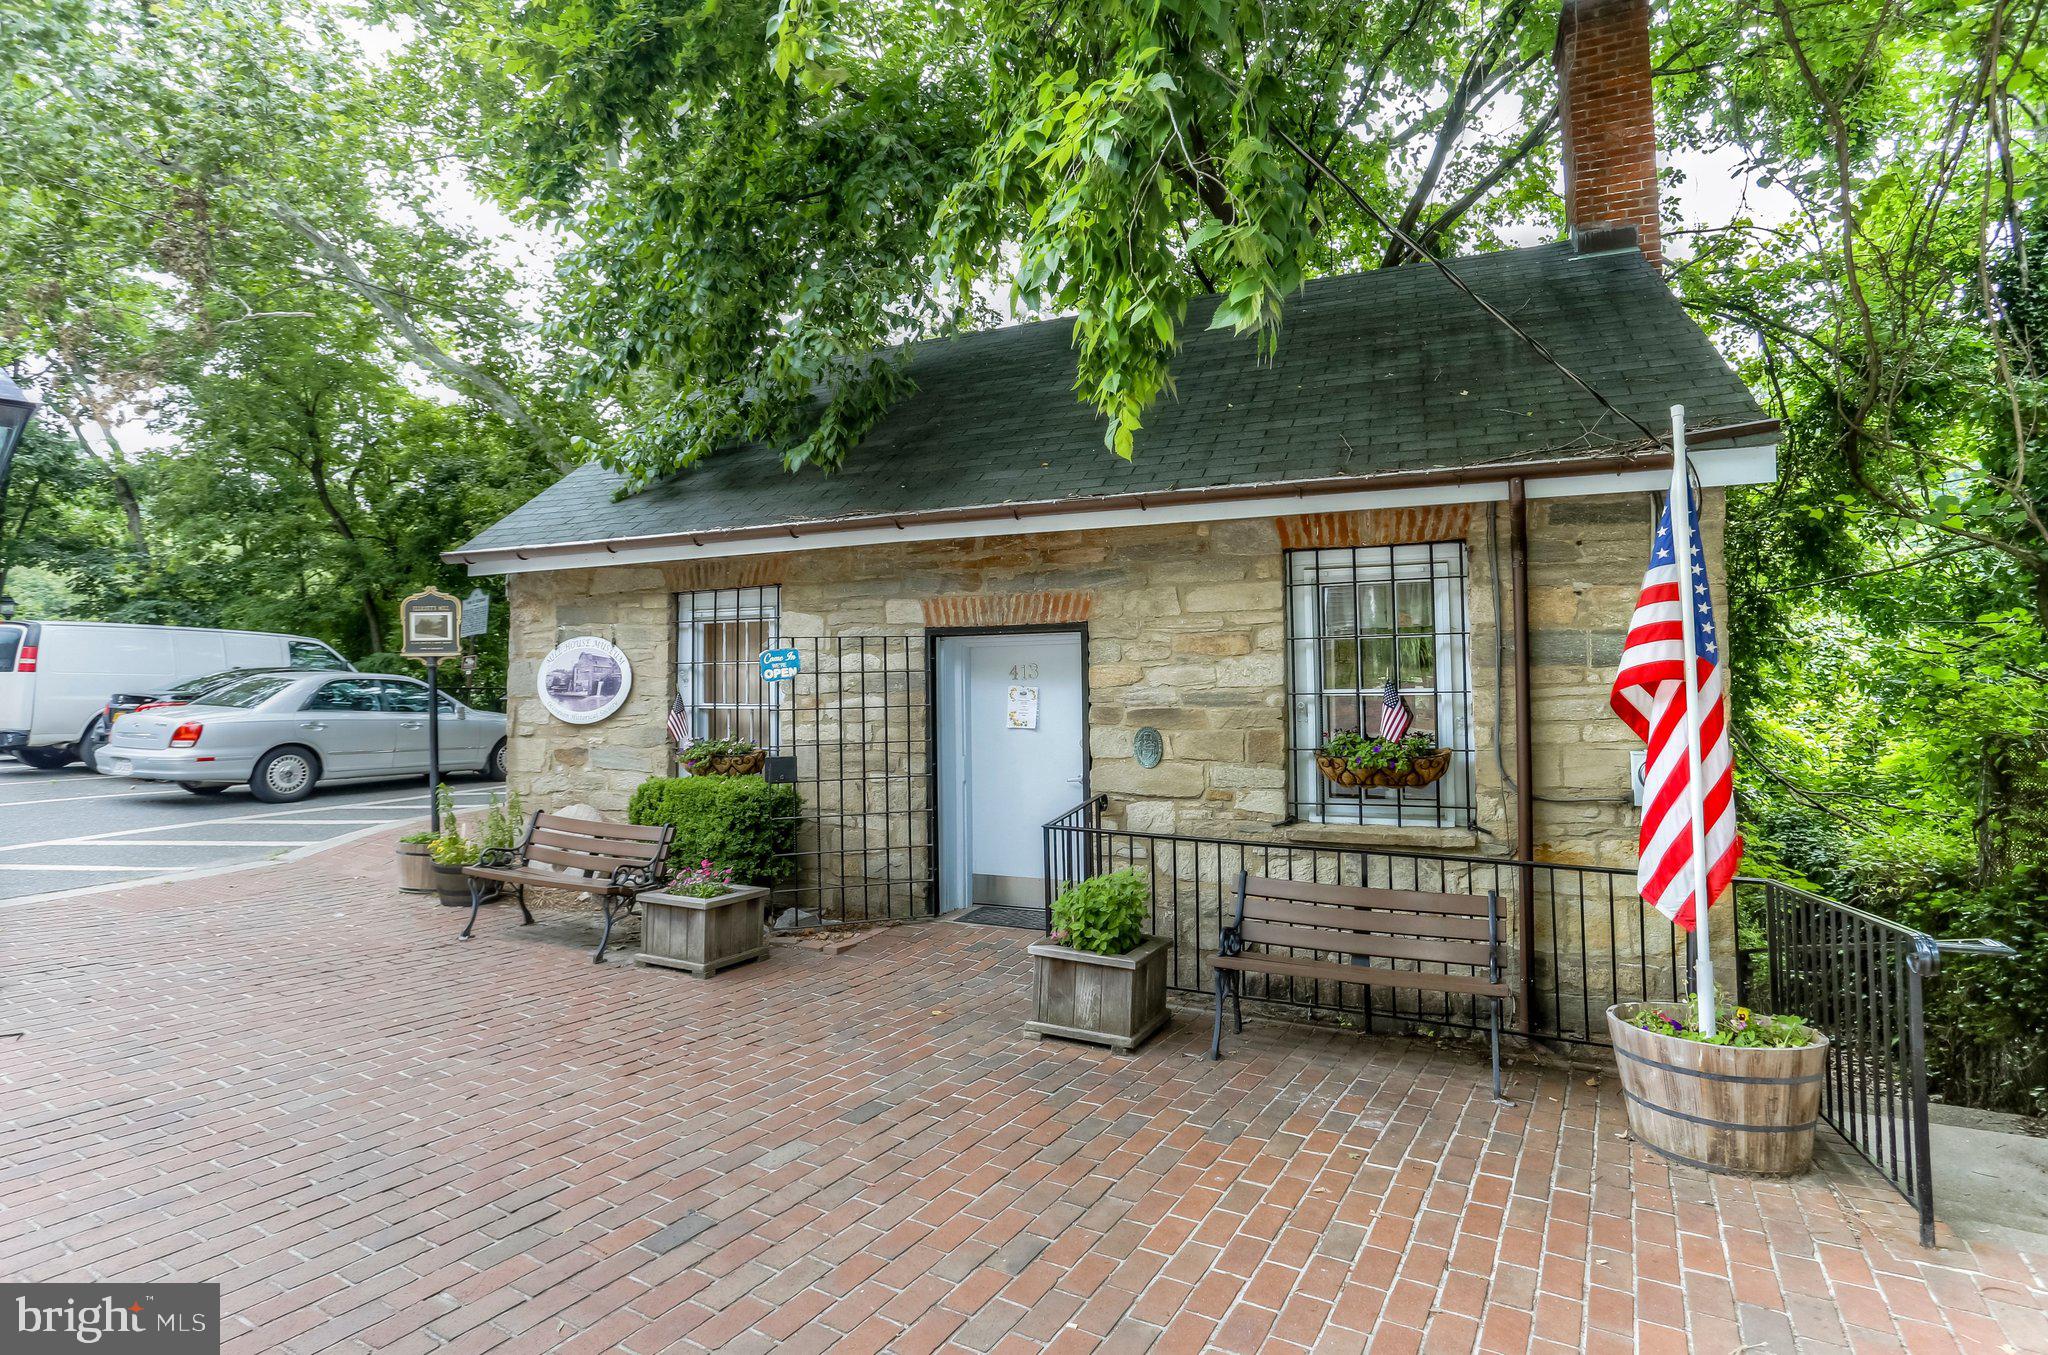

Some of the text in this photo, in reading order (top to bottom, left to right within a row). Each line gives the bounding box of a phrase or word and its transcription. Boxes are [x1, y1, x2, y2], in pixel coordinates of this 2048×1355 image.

[565, 639, 590, 651] HOUSE
[593, 640, 626, 664] MUSEUM
[763, 651, 797, 664] Come In
[764, 667, 797, 679] OPEN
[1009, 663, 1039, 680] 413
